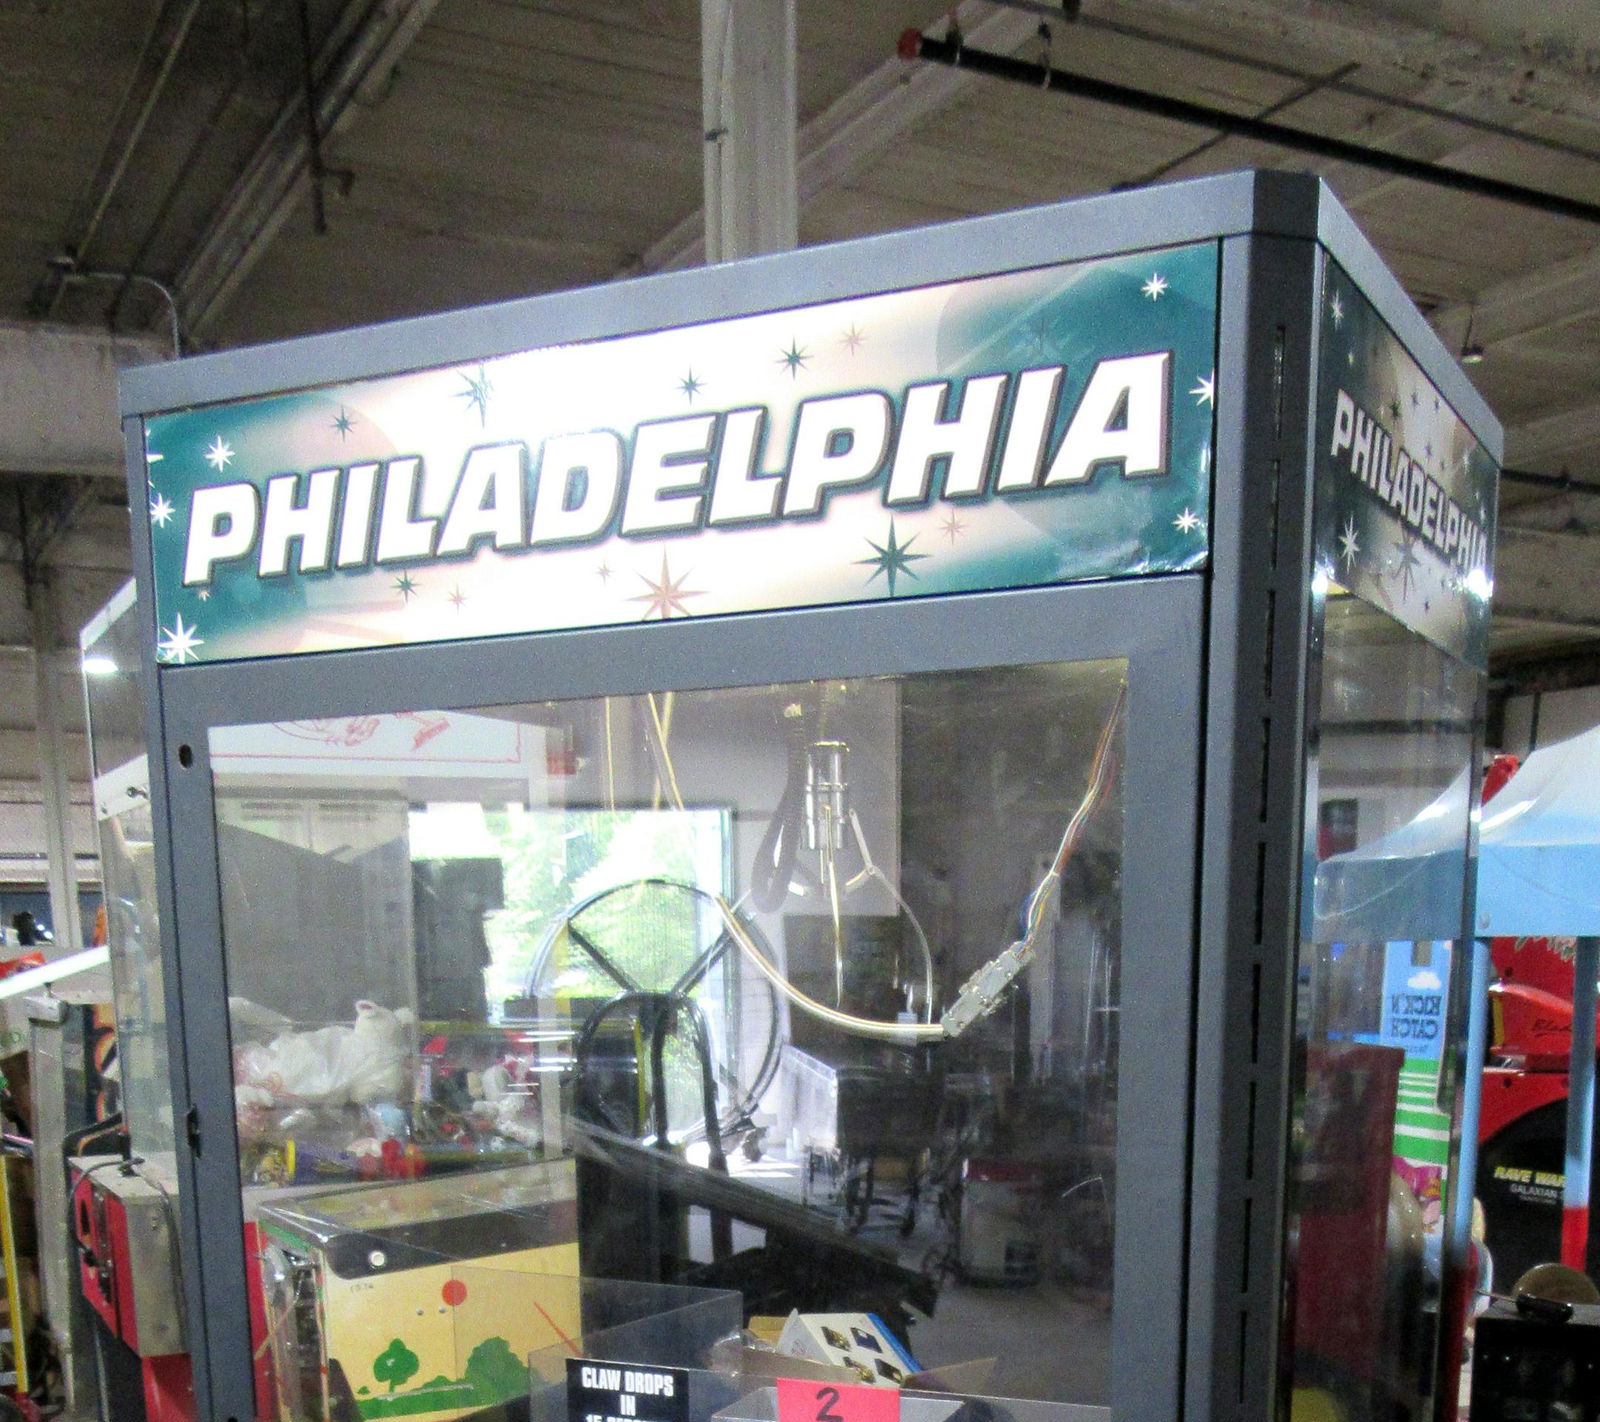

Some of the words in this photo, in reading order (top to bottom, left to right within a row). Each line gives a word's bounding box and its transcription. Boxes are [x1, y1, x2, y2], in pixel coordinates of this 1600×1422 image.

[181, 347, 1174, 588] PHILADELPHIA
[1330, 387, 1488, 576] PHILADELPHIA
[581, 1366, 622, 1391] CLAW
[624, 1370, 674, 1397] DROPS
[620, 1394, 636, 1416] IN
[815, 1386, 844, 1422] 2
